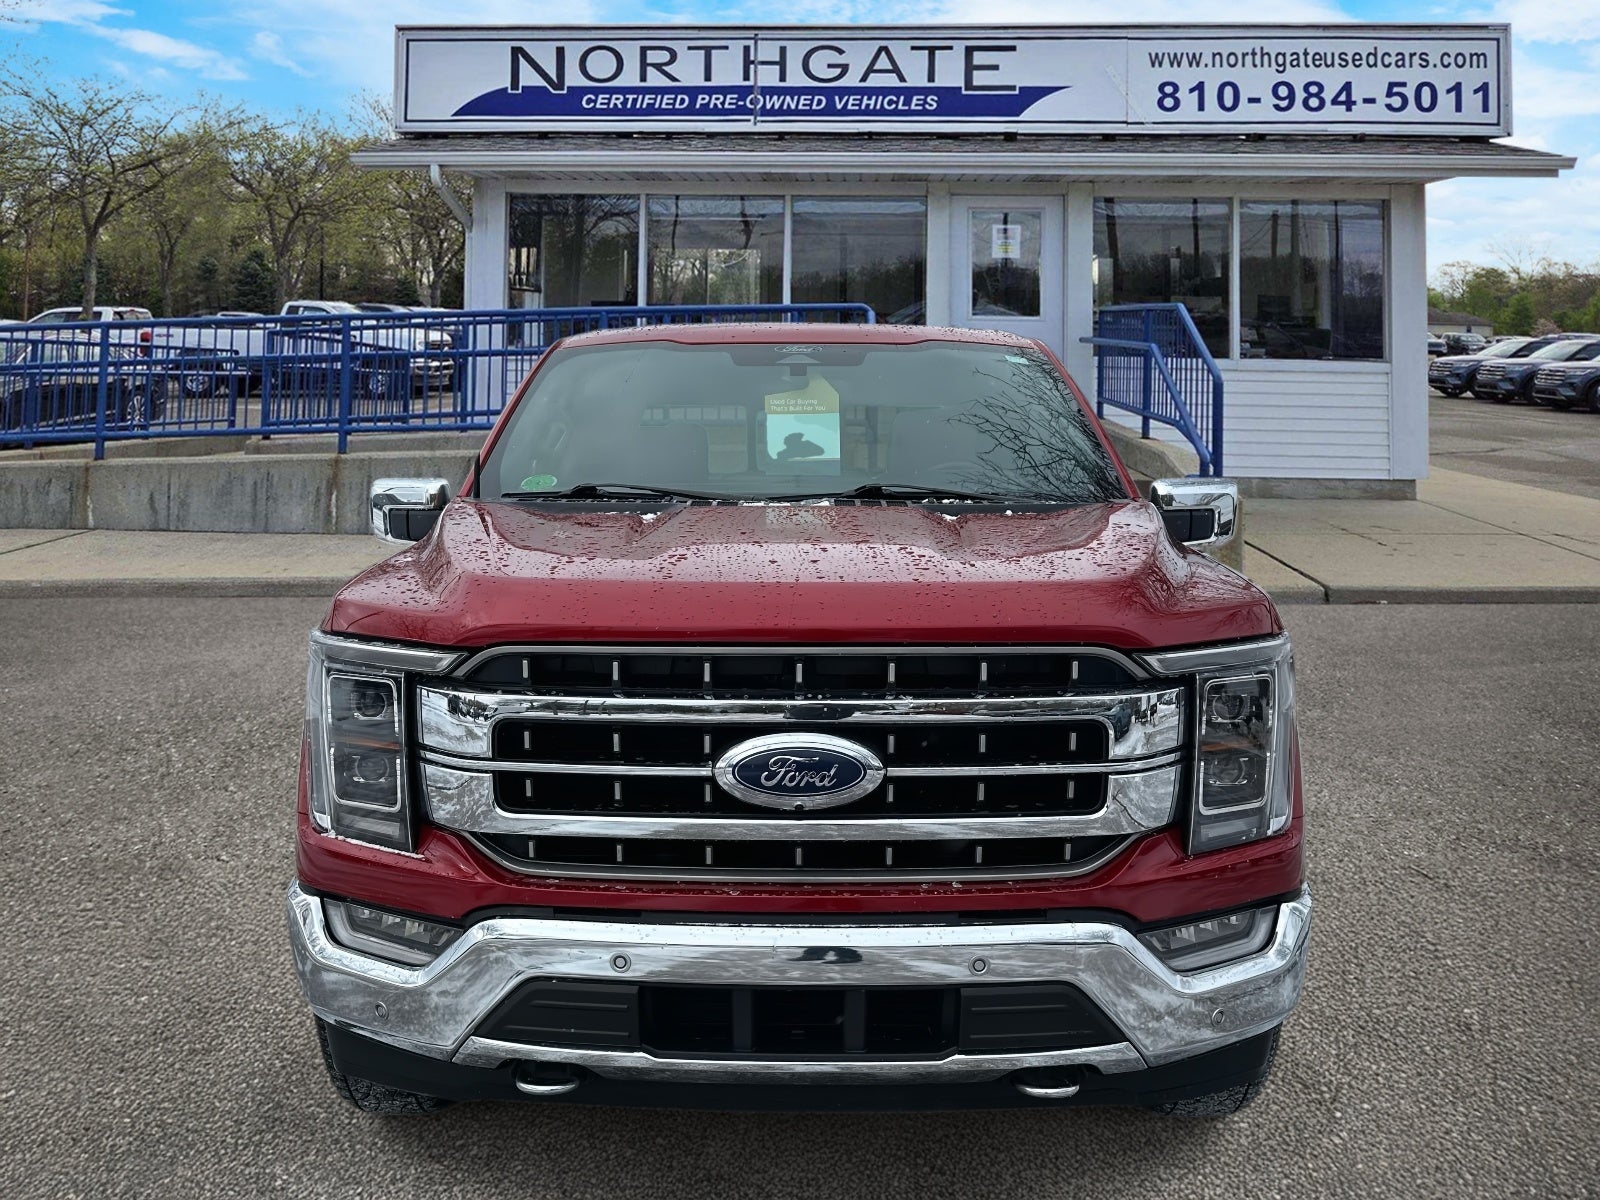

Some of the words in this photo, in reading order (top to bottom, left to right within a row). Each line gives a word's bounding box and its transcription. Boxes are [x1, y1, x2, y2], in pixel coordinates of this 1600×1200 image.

[510, 44, 1018, 92] NORTHGATE
[1148, 46, 1488, 73] www.northgateusedcars.com
[581, 94, 689, 109] CERTIFIED
[695, 94, 826, 110] PRE-OWNED
[834, 95, 939, 110] VEHICLES
[1156, 81, 1491, 113] 810-984-5011
[760, 755, 839, 787] Ford
